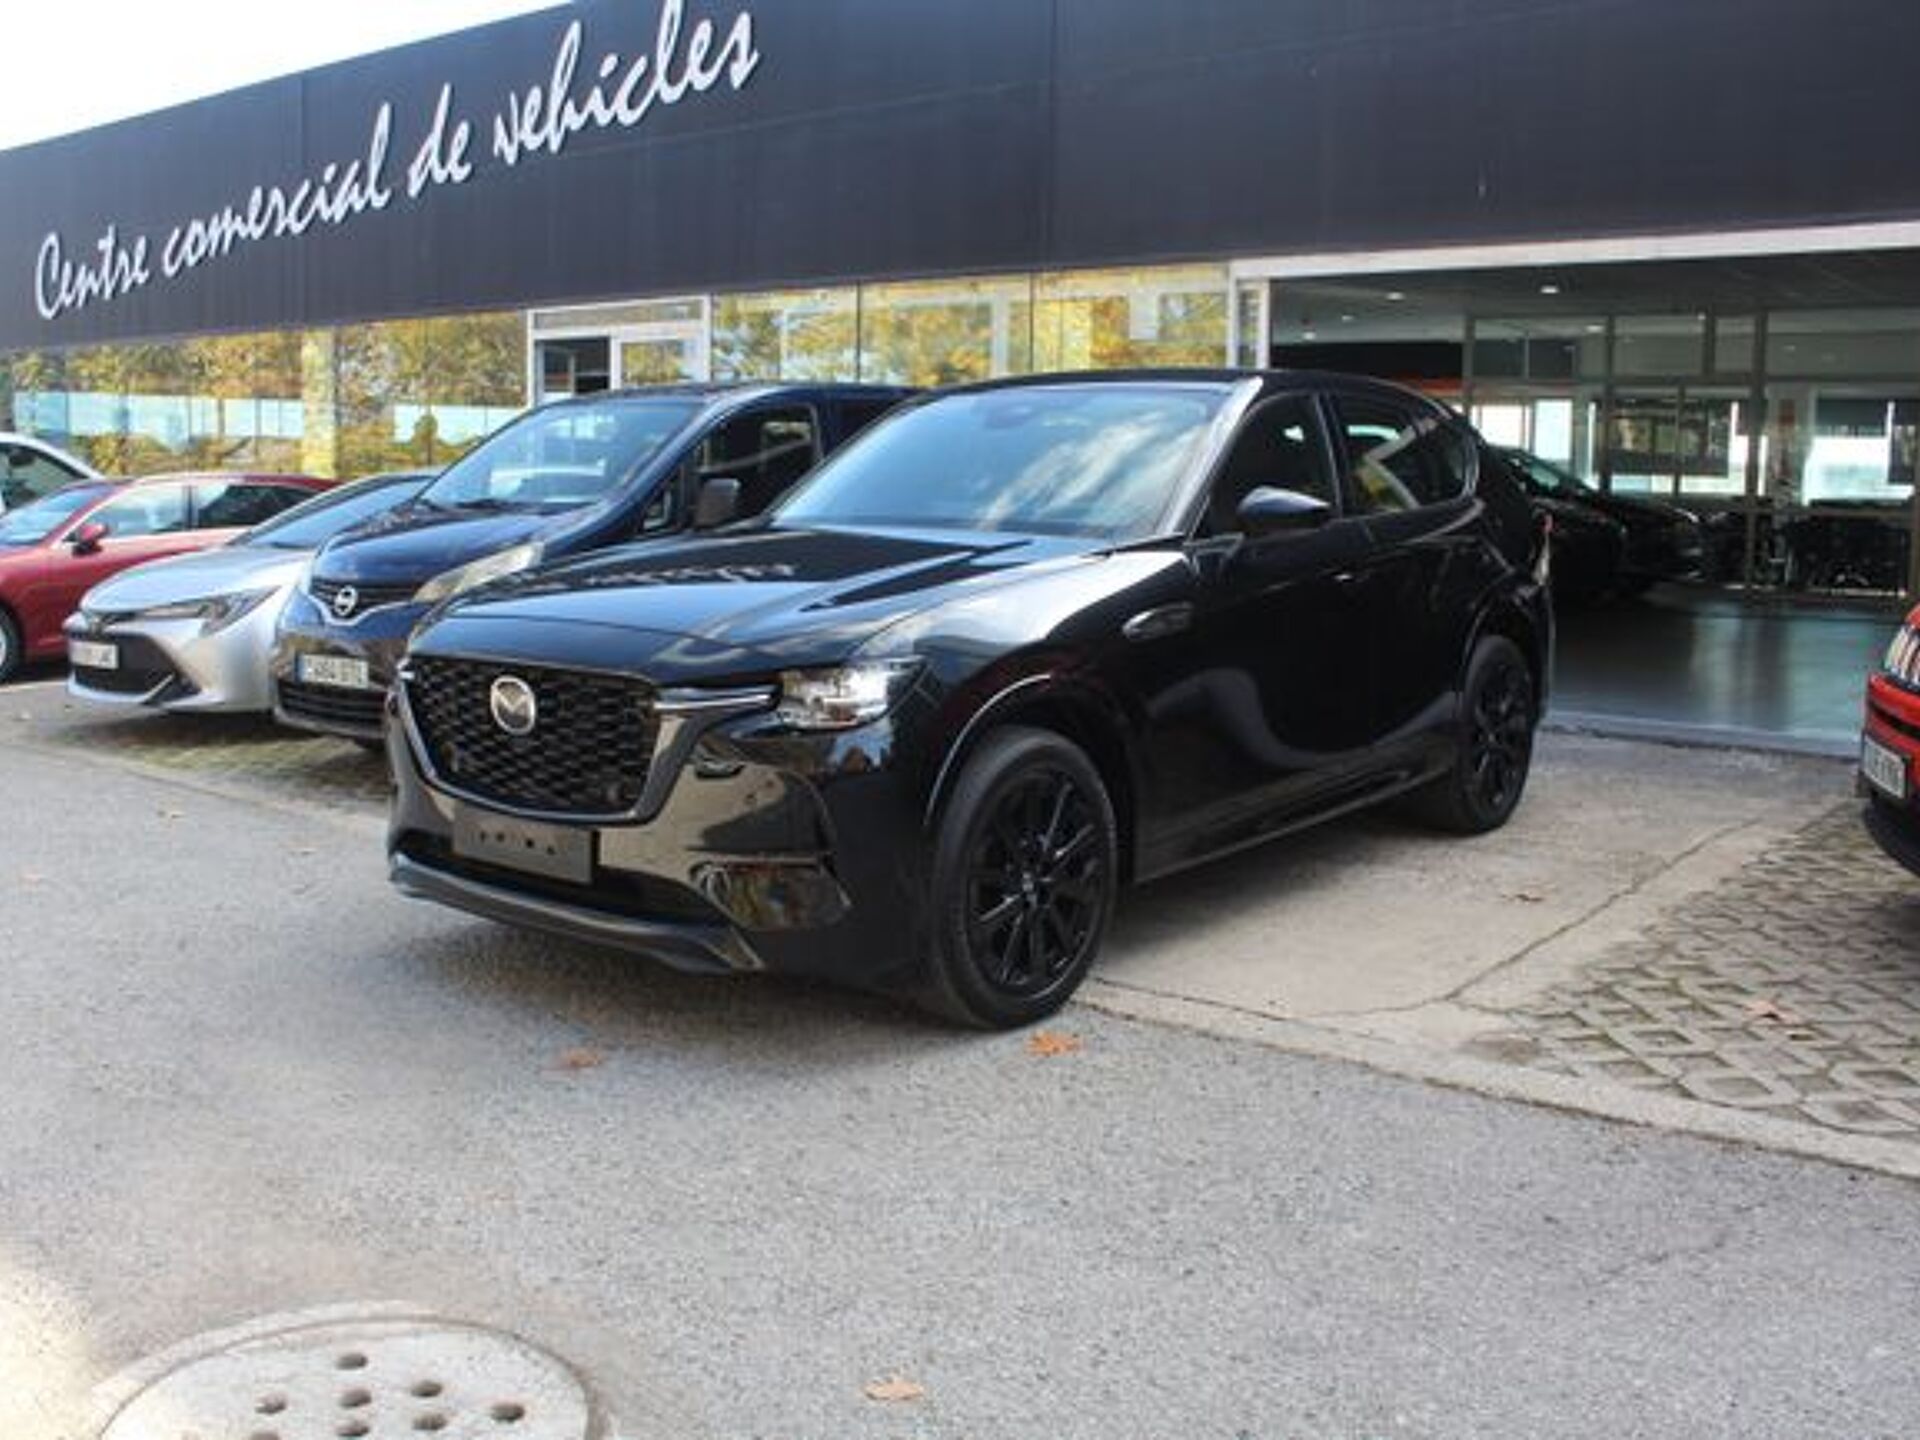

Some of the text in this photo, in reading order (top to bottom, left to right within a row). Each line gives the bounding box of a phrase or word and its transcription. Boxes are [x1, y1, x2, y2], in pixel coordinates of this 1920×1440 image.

[35, 0, 759, 320] Centre comercial de vehicles
